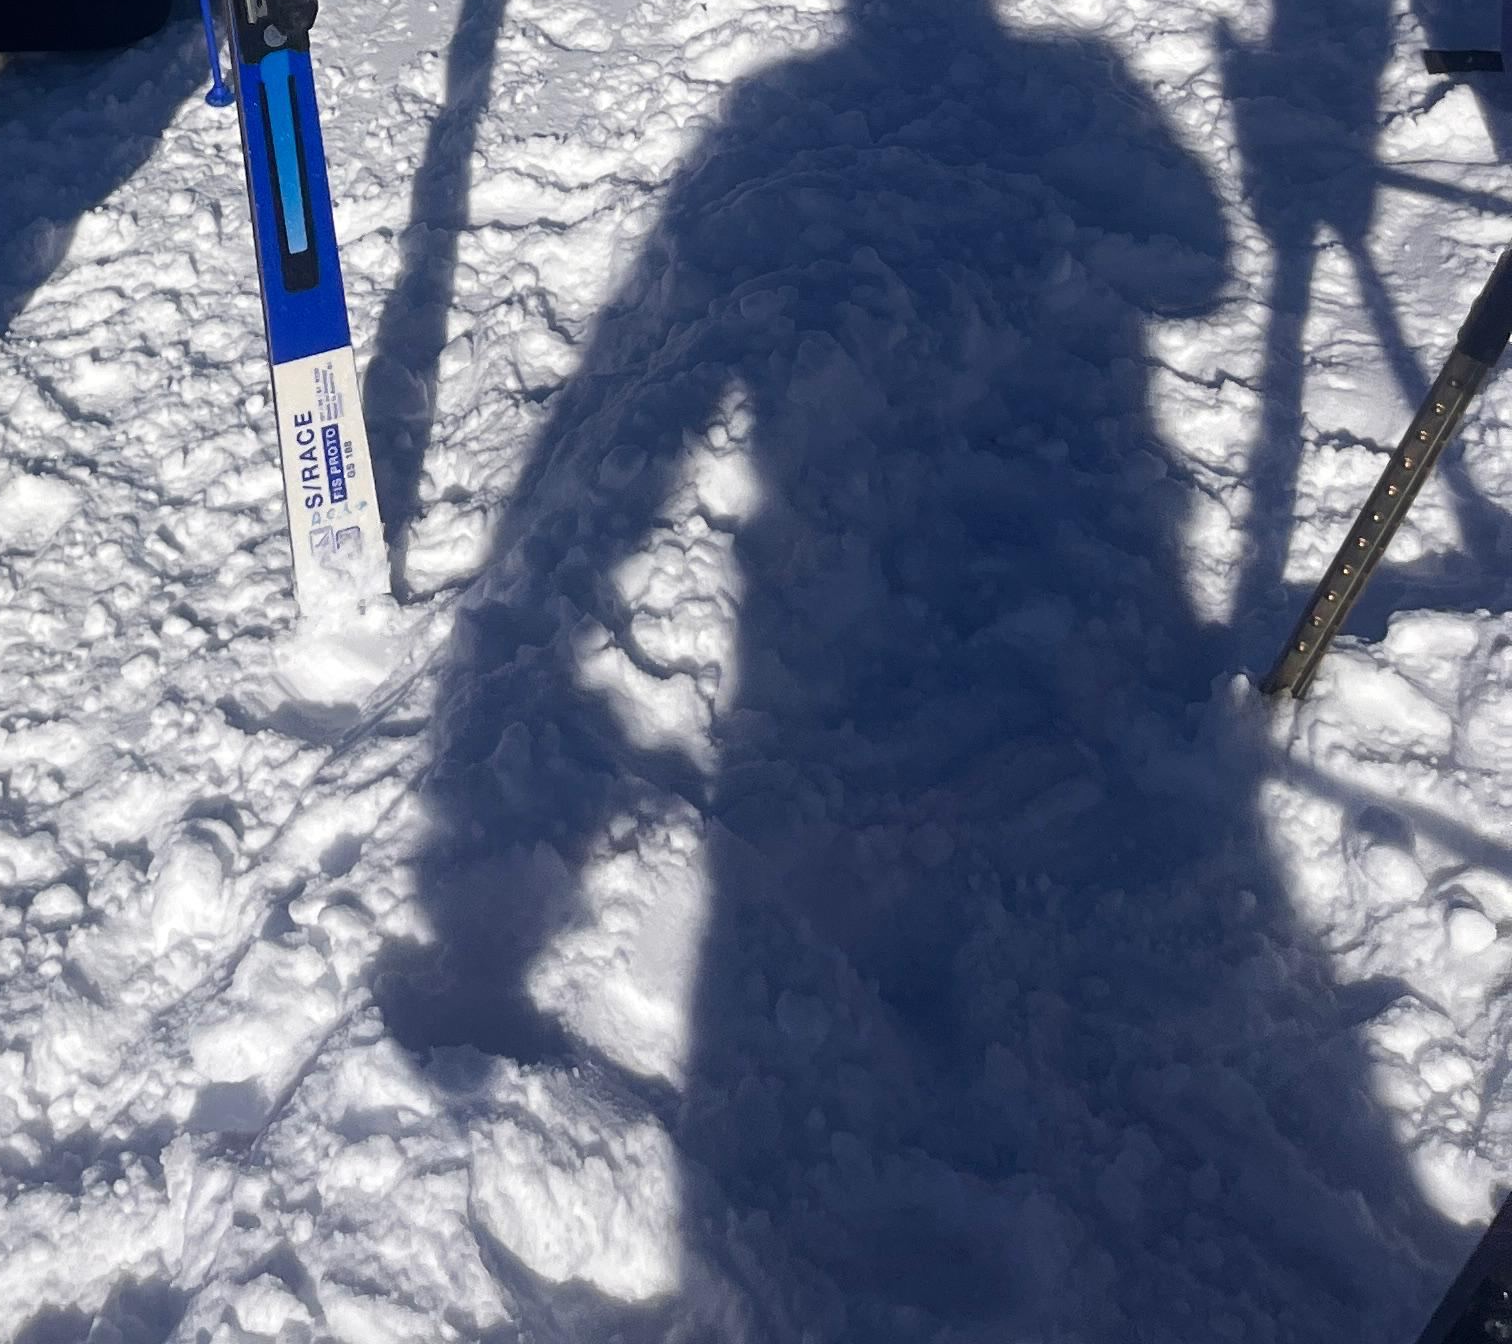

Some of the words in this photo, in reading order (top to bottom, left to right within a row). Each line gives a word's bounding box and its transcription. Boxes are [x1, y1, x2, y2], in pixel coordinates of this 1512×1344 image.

[294, 410, 324, 510] S/RACE
[324, 426, 343, 475] PROTO
[330, 476, 345, 504] FIS
